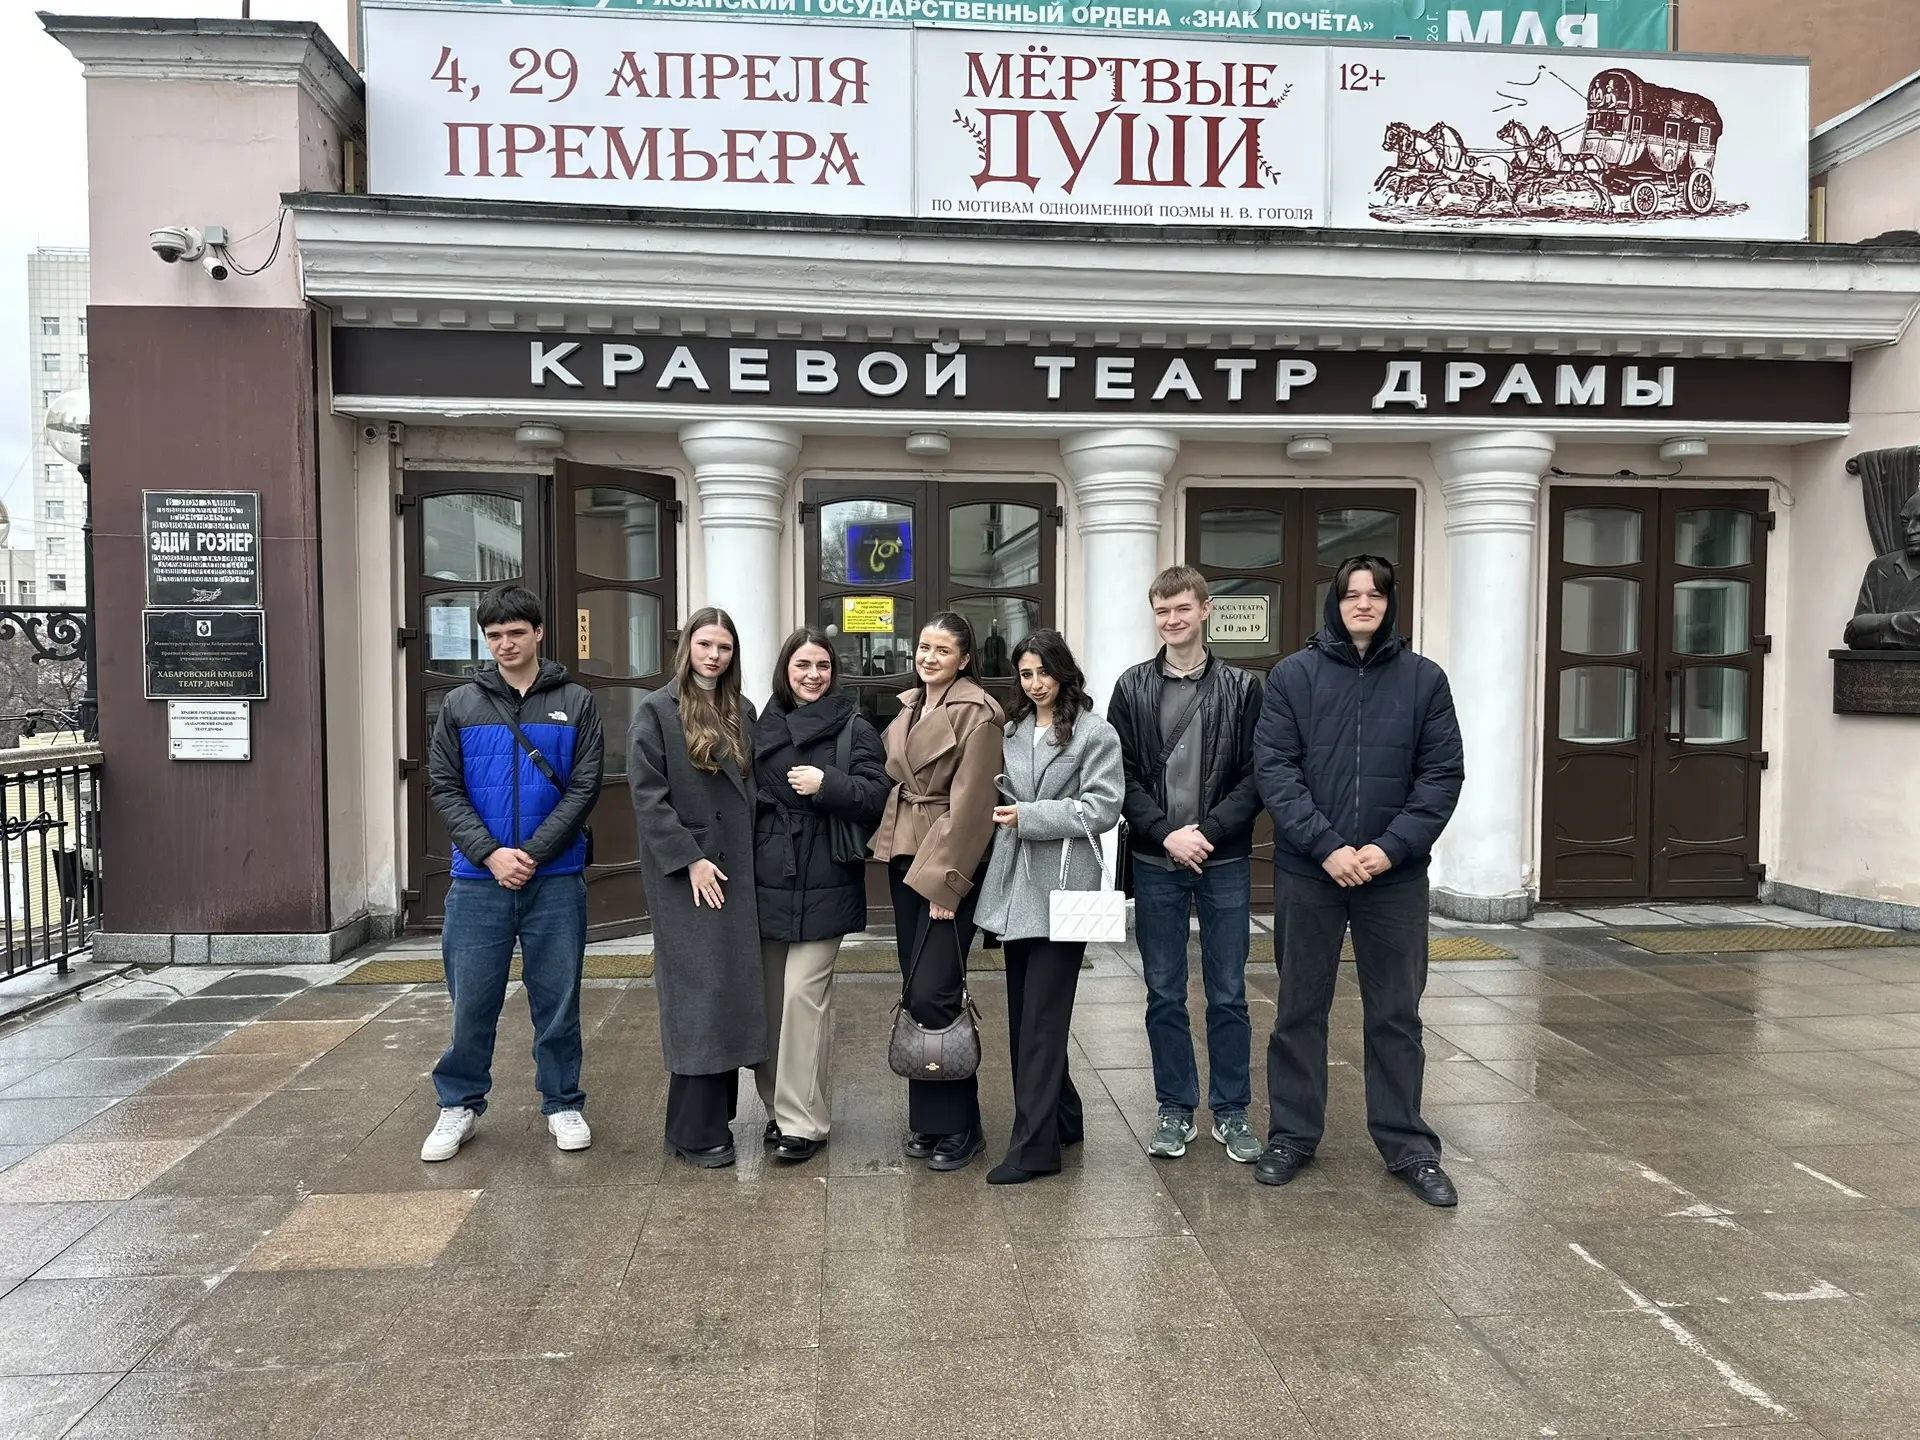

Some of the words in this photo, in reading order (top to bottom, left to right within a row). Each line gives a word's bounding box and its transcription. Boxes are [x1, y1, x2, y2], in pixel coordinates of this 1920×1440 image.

[636, 0, 795, 11] НСКИЙ
[1071, 6, 1171, 29] ОРДЕНА
[1180, 9, 1257, 29] «ЗНАК
[1267, 8, 1375, 33] ПОЧЁТА»
[1447, 10, 1599, 48] МАЯ
[430, 45, 480, 102] 4,
[508, 47, 579, 102] 29
[604, 50, 870, 107] АПРЕЛЯ
[964, 44, 1280, 109] МЁРТВЫЕ
[1339, 62, 1387, 92] 12+
[442, 121, 867, 186] ПРЕМЬЕРА
[969, 104, 1266, 196] ДУШИ
[931, 199, 953, 212] ПО
[957, 200, 1034, 215] МОТИВАМ
[1039, 202, 1154, 218] ОДНОИМЕННОЙ
[1159, 205, 1215, 219] ПОЭМЫ
[1220, 207, 1234, 219] Н.
[1239, 208, 1252, 219] В.
[1258, 207, 1314, 220] ГОГОЛЯ
[529, 340, 967, 398] КРАЕВОЙ
[1034, 356, 1318, 402] ТЕАТР
[1372, 360, 1674, 411] ДРАМЫ
[150, 532, 190, 553] ЭДДИ
[197, 532, 254, 552] РОЗНЕР
[1224, 624, 1234, 632] 10
[1250, 624, 1261, 632] 19
[157, 669, 216, 678] ХАБАРОВСКИЙ
[218, 670, 254, 678] КРАЕВОЙ
[179, 680, 203, 688] ТЕАТР
[204, 680, 234, 689] ДРАМЫ
